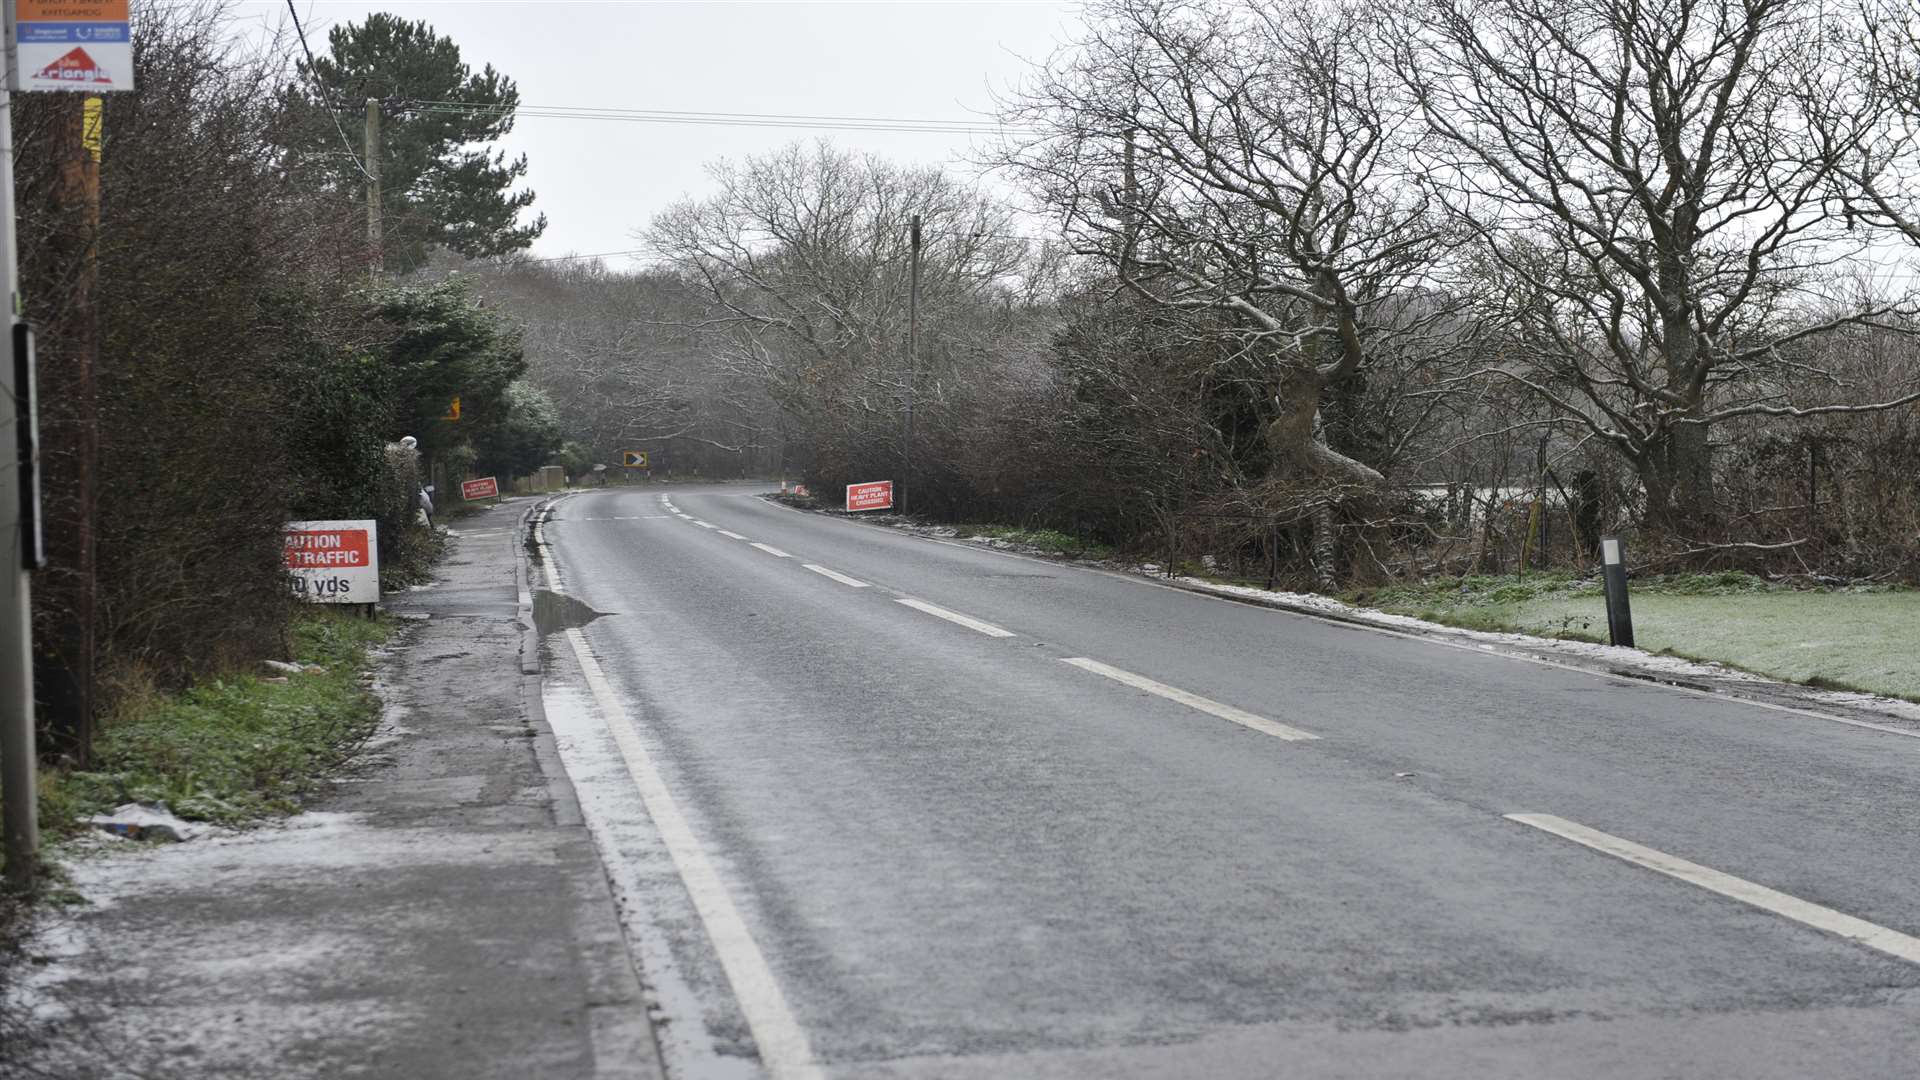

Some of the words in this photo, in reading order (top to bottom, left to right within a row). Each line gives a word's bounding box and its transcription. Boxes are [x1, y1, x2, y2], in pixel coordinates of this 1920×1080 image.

[857, 487, 882, 495] CAUTION
[285, 534, 342, 548] AUTION
[294, 550, 360, 565] TRAFFIC
[314, 576, 350, 596] yds
